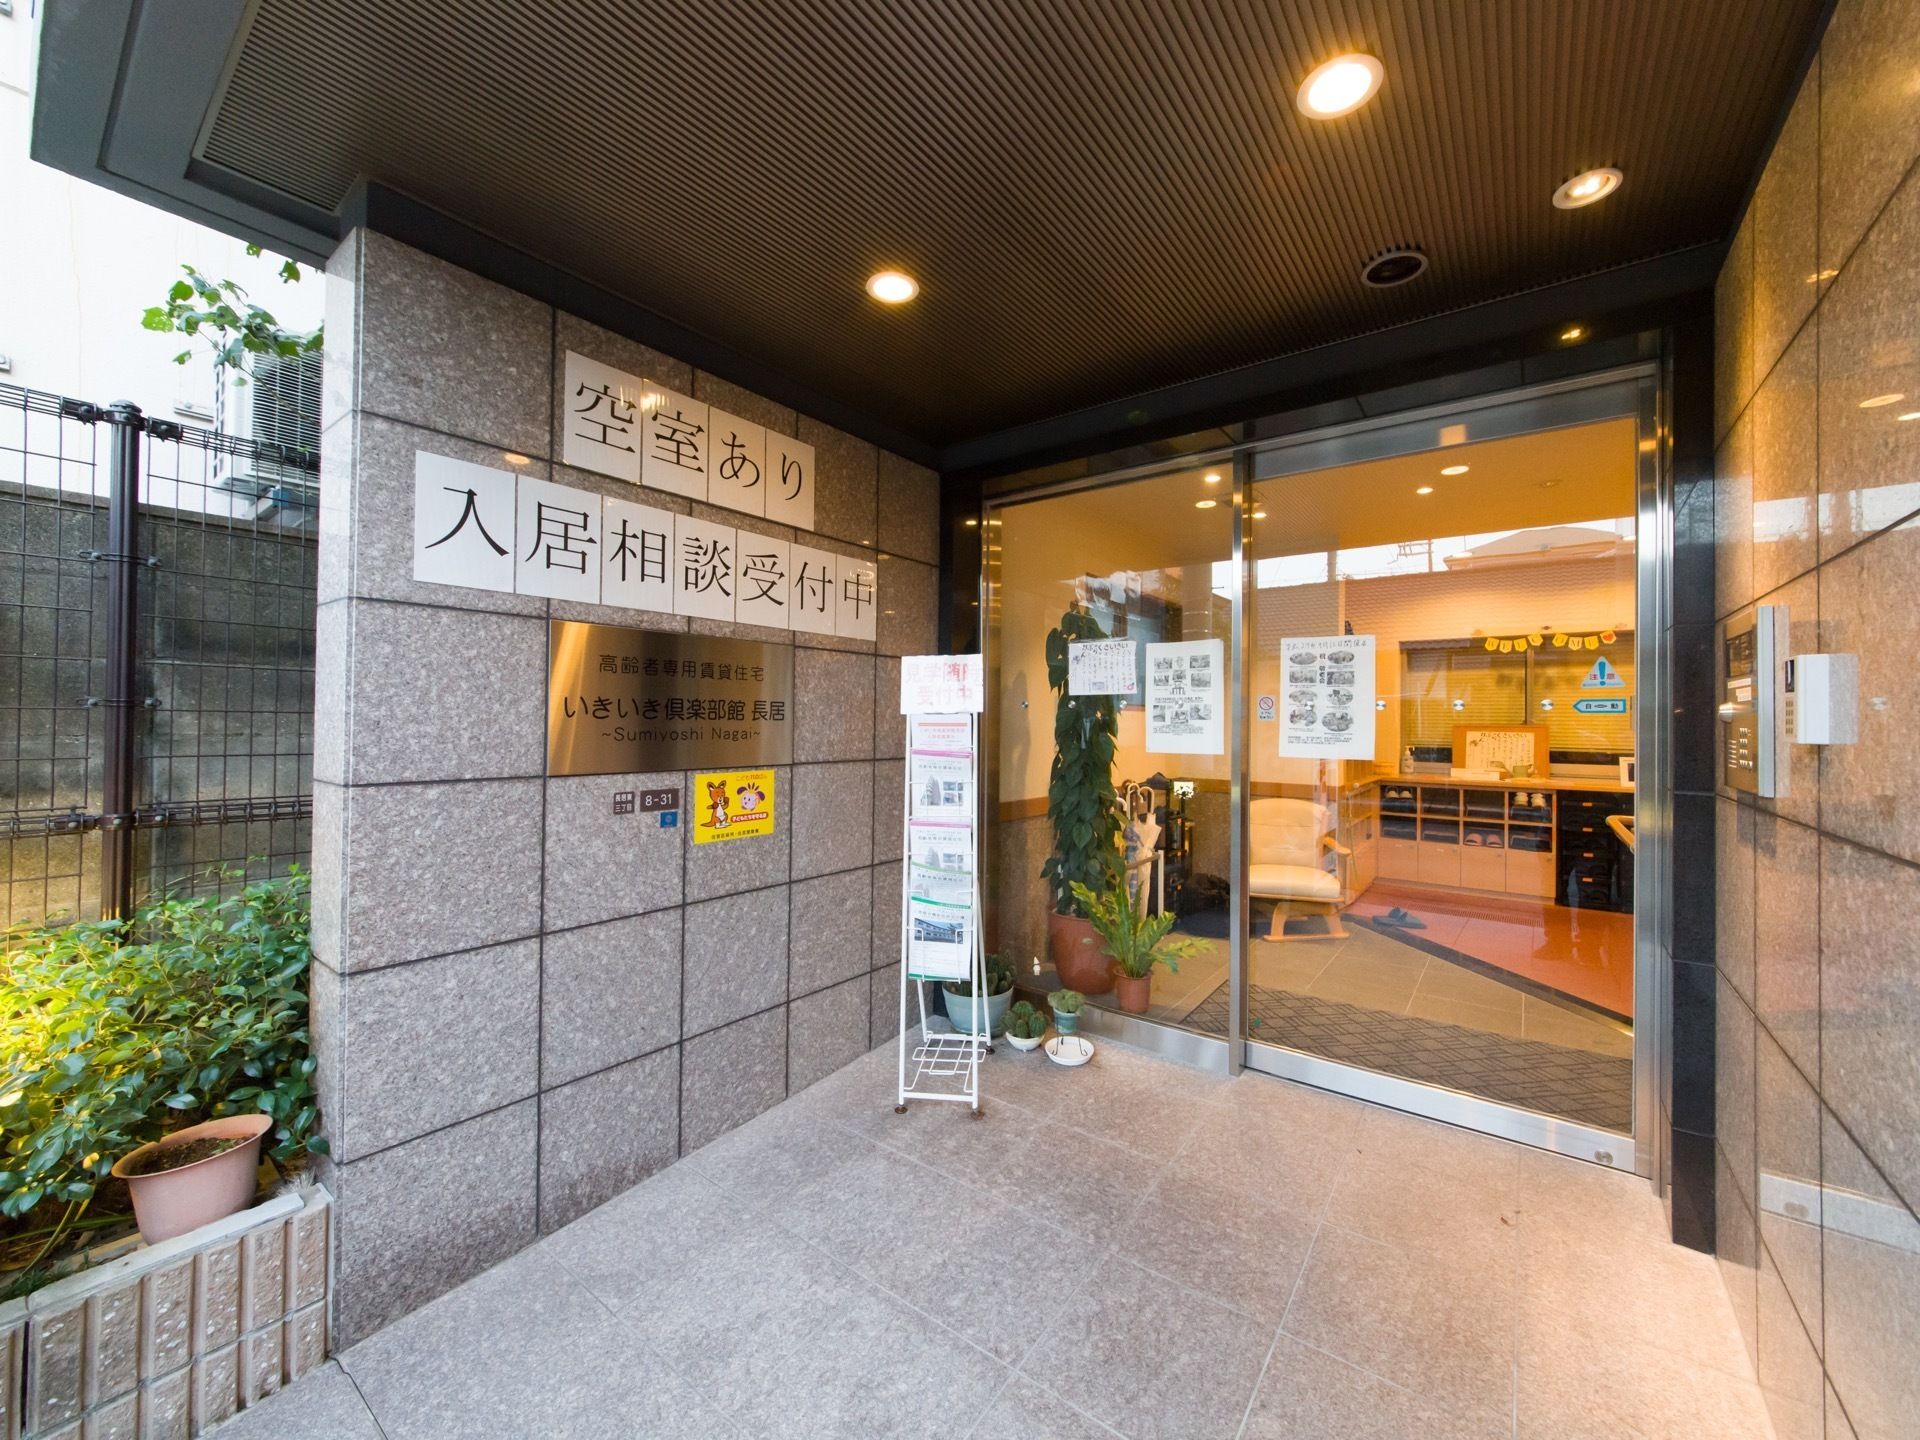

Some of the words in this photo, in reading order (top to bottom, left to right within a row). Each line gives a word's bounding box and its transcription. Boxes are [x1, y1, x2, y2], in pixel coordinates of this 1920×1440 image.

[574, 381, 803, 501] 空室あり
[424, 486, 873, 620] 入居相談受付中
[599, 653, 765, 682] 高齢者専用賃貸住宅
[563, 695, 745, 721] いきいき倶楽部館
[751, 700, 785, 721] 長居
[645, 793, 672, 806] 8-31
